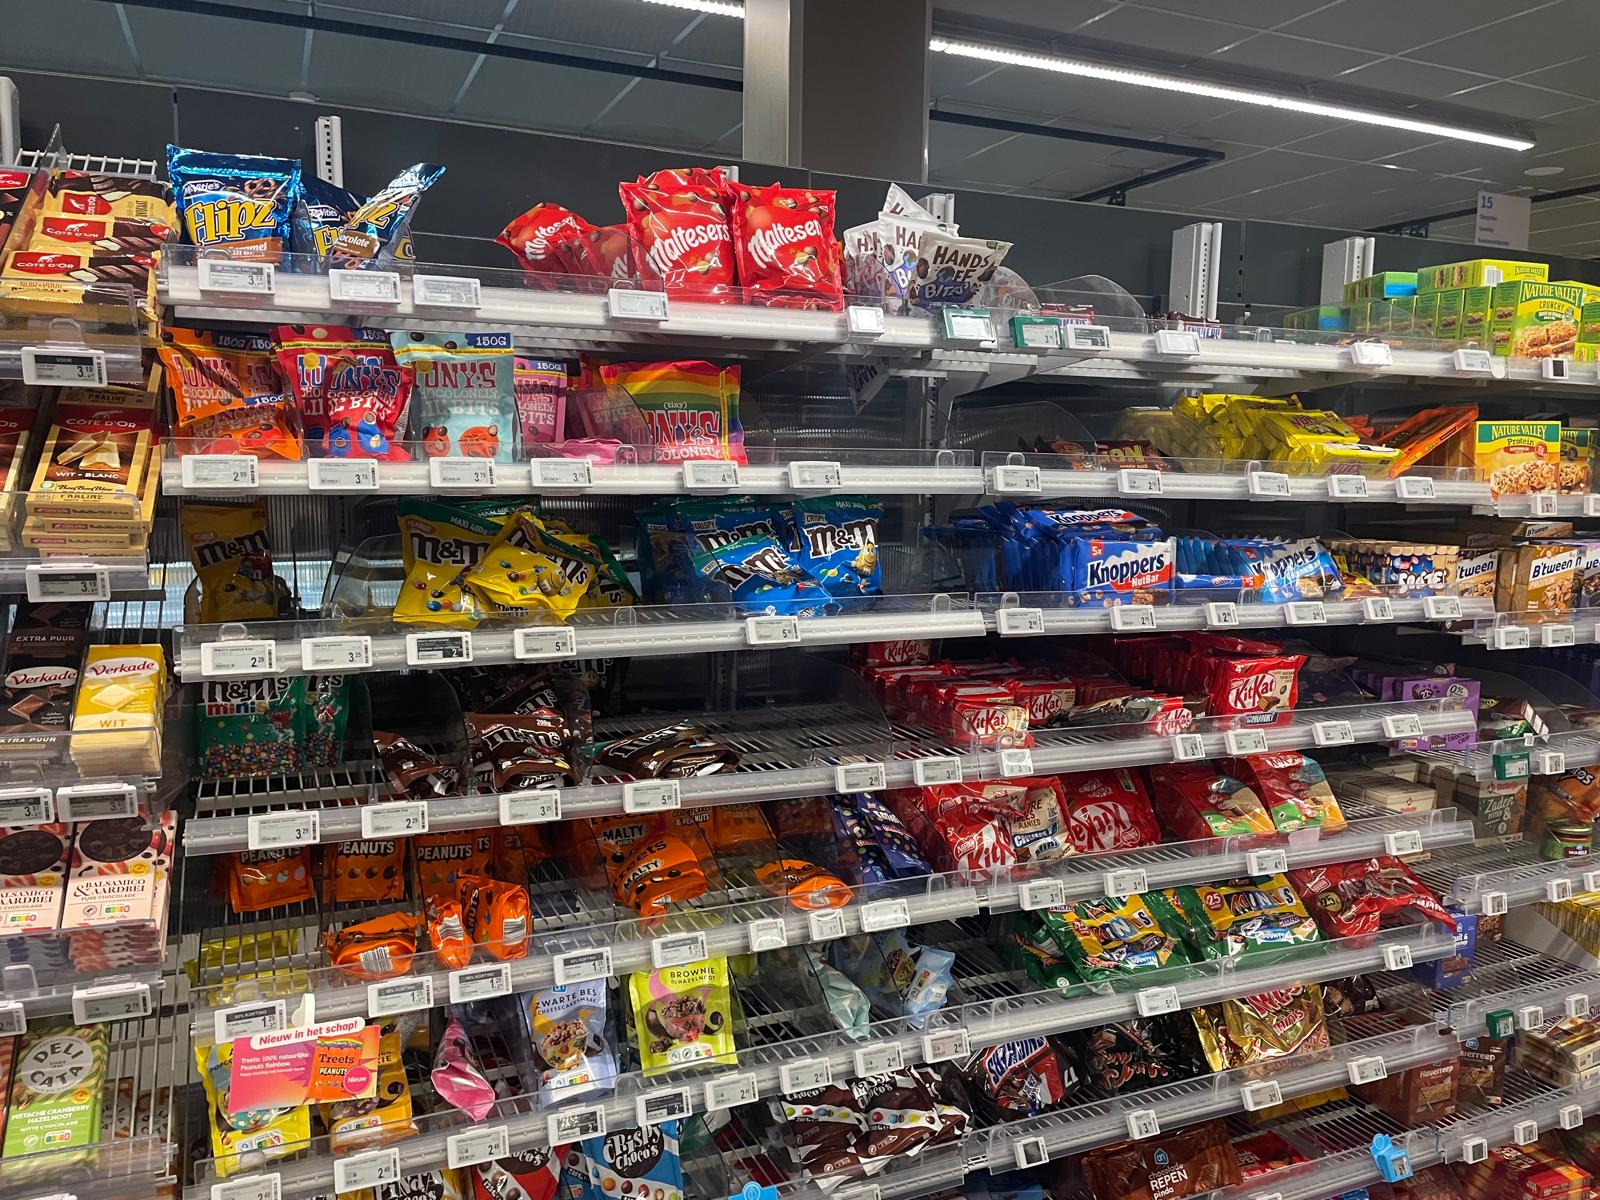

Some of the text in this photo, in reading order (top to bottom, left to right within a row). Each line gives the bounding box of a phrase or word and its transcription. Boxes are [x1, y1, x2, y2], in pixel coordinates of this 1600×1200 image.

[184, 200, 278, 246] Flipz
[648, 222, 732, 269] Maltesers
[934, 246, 993, 273] HANDS
[1523, 282, 1581, 304] NATURE VALLEY
[1539, 300, 1565, 310] CRUNCHY
[476, 336, 506, 347] 150G
[66, 418, 136, 428] CÔTE D'OR
[1492, 424, 1547, 440] NATURE VALLEY
[1507, 437, 1534, 448] Protein
[85, 472, 119, 480] BLANC
[805, 513, 826, 523] CRISPY
[1054, 509, 1121, 526] Knoppers
[1092, 546, 1103, 557] 5x
[1089, 553, 1165, 586] Knoppers
[1532, 559, 1573, 580] B'tween
[1132, 573, 1160, 587] NutBar
[16, 635, 46, 643] EXTRA
[886, 641, 921, 662] KitKat
[89, 661, 156, 677] Verkade
[11, 670, 77, 686] Verkade
[1232, 674, 1275, 709] KitKat
[208, 701, 268, 716] minis
[1029, 693, 1063, 721] KitKat
[100, 719, 128, 728] WIT
[967, 707, 1009, 734] KitKat
[603, 824, 645, 841] MALTY
[337, 840, 395, 855] PEANUTS
[417, 844, 473, 860] PEANUTS
[623, 859, 661, 891] MALTY
[74, 882, 146, 899] & AARDBEI
[86, 879, 146, 889] BALSAMICO
[1206, 894, 1222, 906] 25
[1230, 890, 1296, 917] MINIS
[670, 967, 715, 980] BROWNIE
[534, 988, 598, 1010] ZWARTE BES
[259, 1021, 358, 1046] Nieuw in het schap!
[33, 1042, 84, 1064] DELI
[261, 1055, 277, 1063] 100%
[278, 1052, 309, 1064] natuurlijke
[318, 1054, 354, 1067] Treets
[31, 1065, 84, 1088] CATA
[241, 1063, 264, 1074] Peanuts
[319, 1067, 349, 1079] PEANUTS
[348, 1076, 367, 1085] Nieuw
[11, 1104, 90, 1121] PISTACHE CRANBERRY
[27, 1113, 73, 1125] HAZELNOOT
[41, 1120, 78, 1130] CHOCOLADE
[1148, 1163, 1184, 1180] chocolade
[1150, 1170, 1189, 1190] REPEN
[1154, 1186, 1175, 1200] pinda
